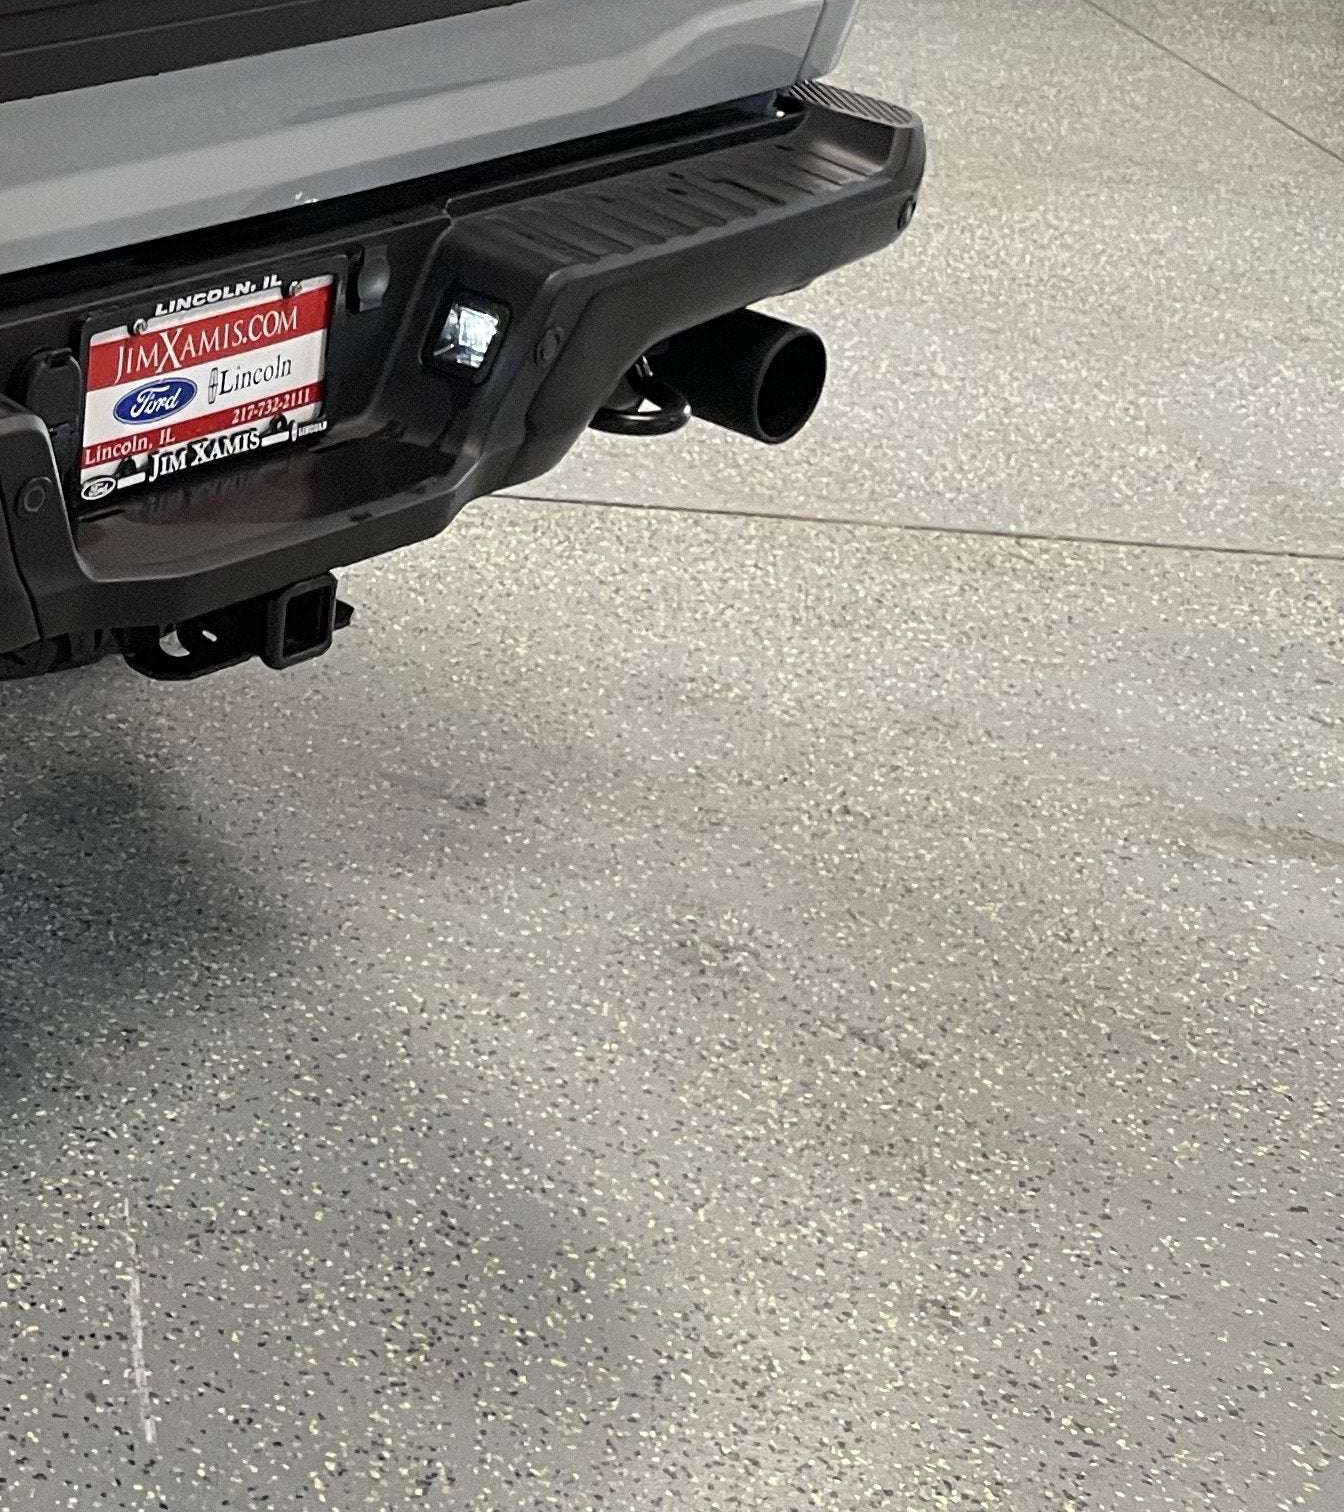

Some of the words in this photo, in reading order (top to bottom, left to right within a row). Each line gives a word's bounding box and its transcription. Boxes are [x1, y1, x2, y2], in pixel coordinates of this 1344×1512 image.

[263, 274, 282, 289] IL
[114, 305, 298, 384] JIMXAMIS.COM
[218, 355, 292, 396] Lincoln
[130, 386, 182, 418] Ford
[231, 388, 311, 424] 217-732-2111
[160, 427, 176, 444] IL
[149, 453, 187, 482] JIM
[191, 431, 261, 466] XAMIS
